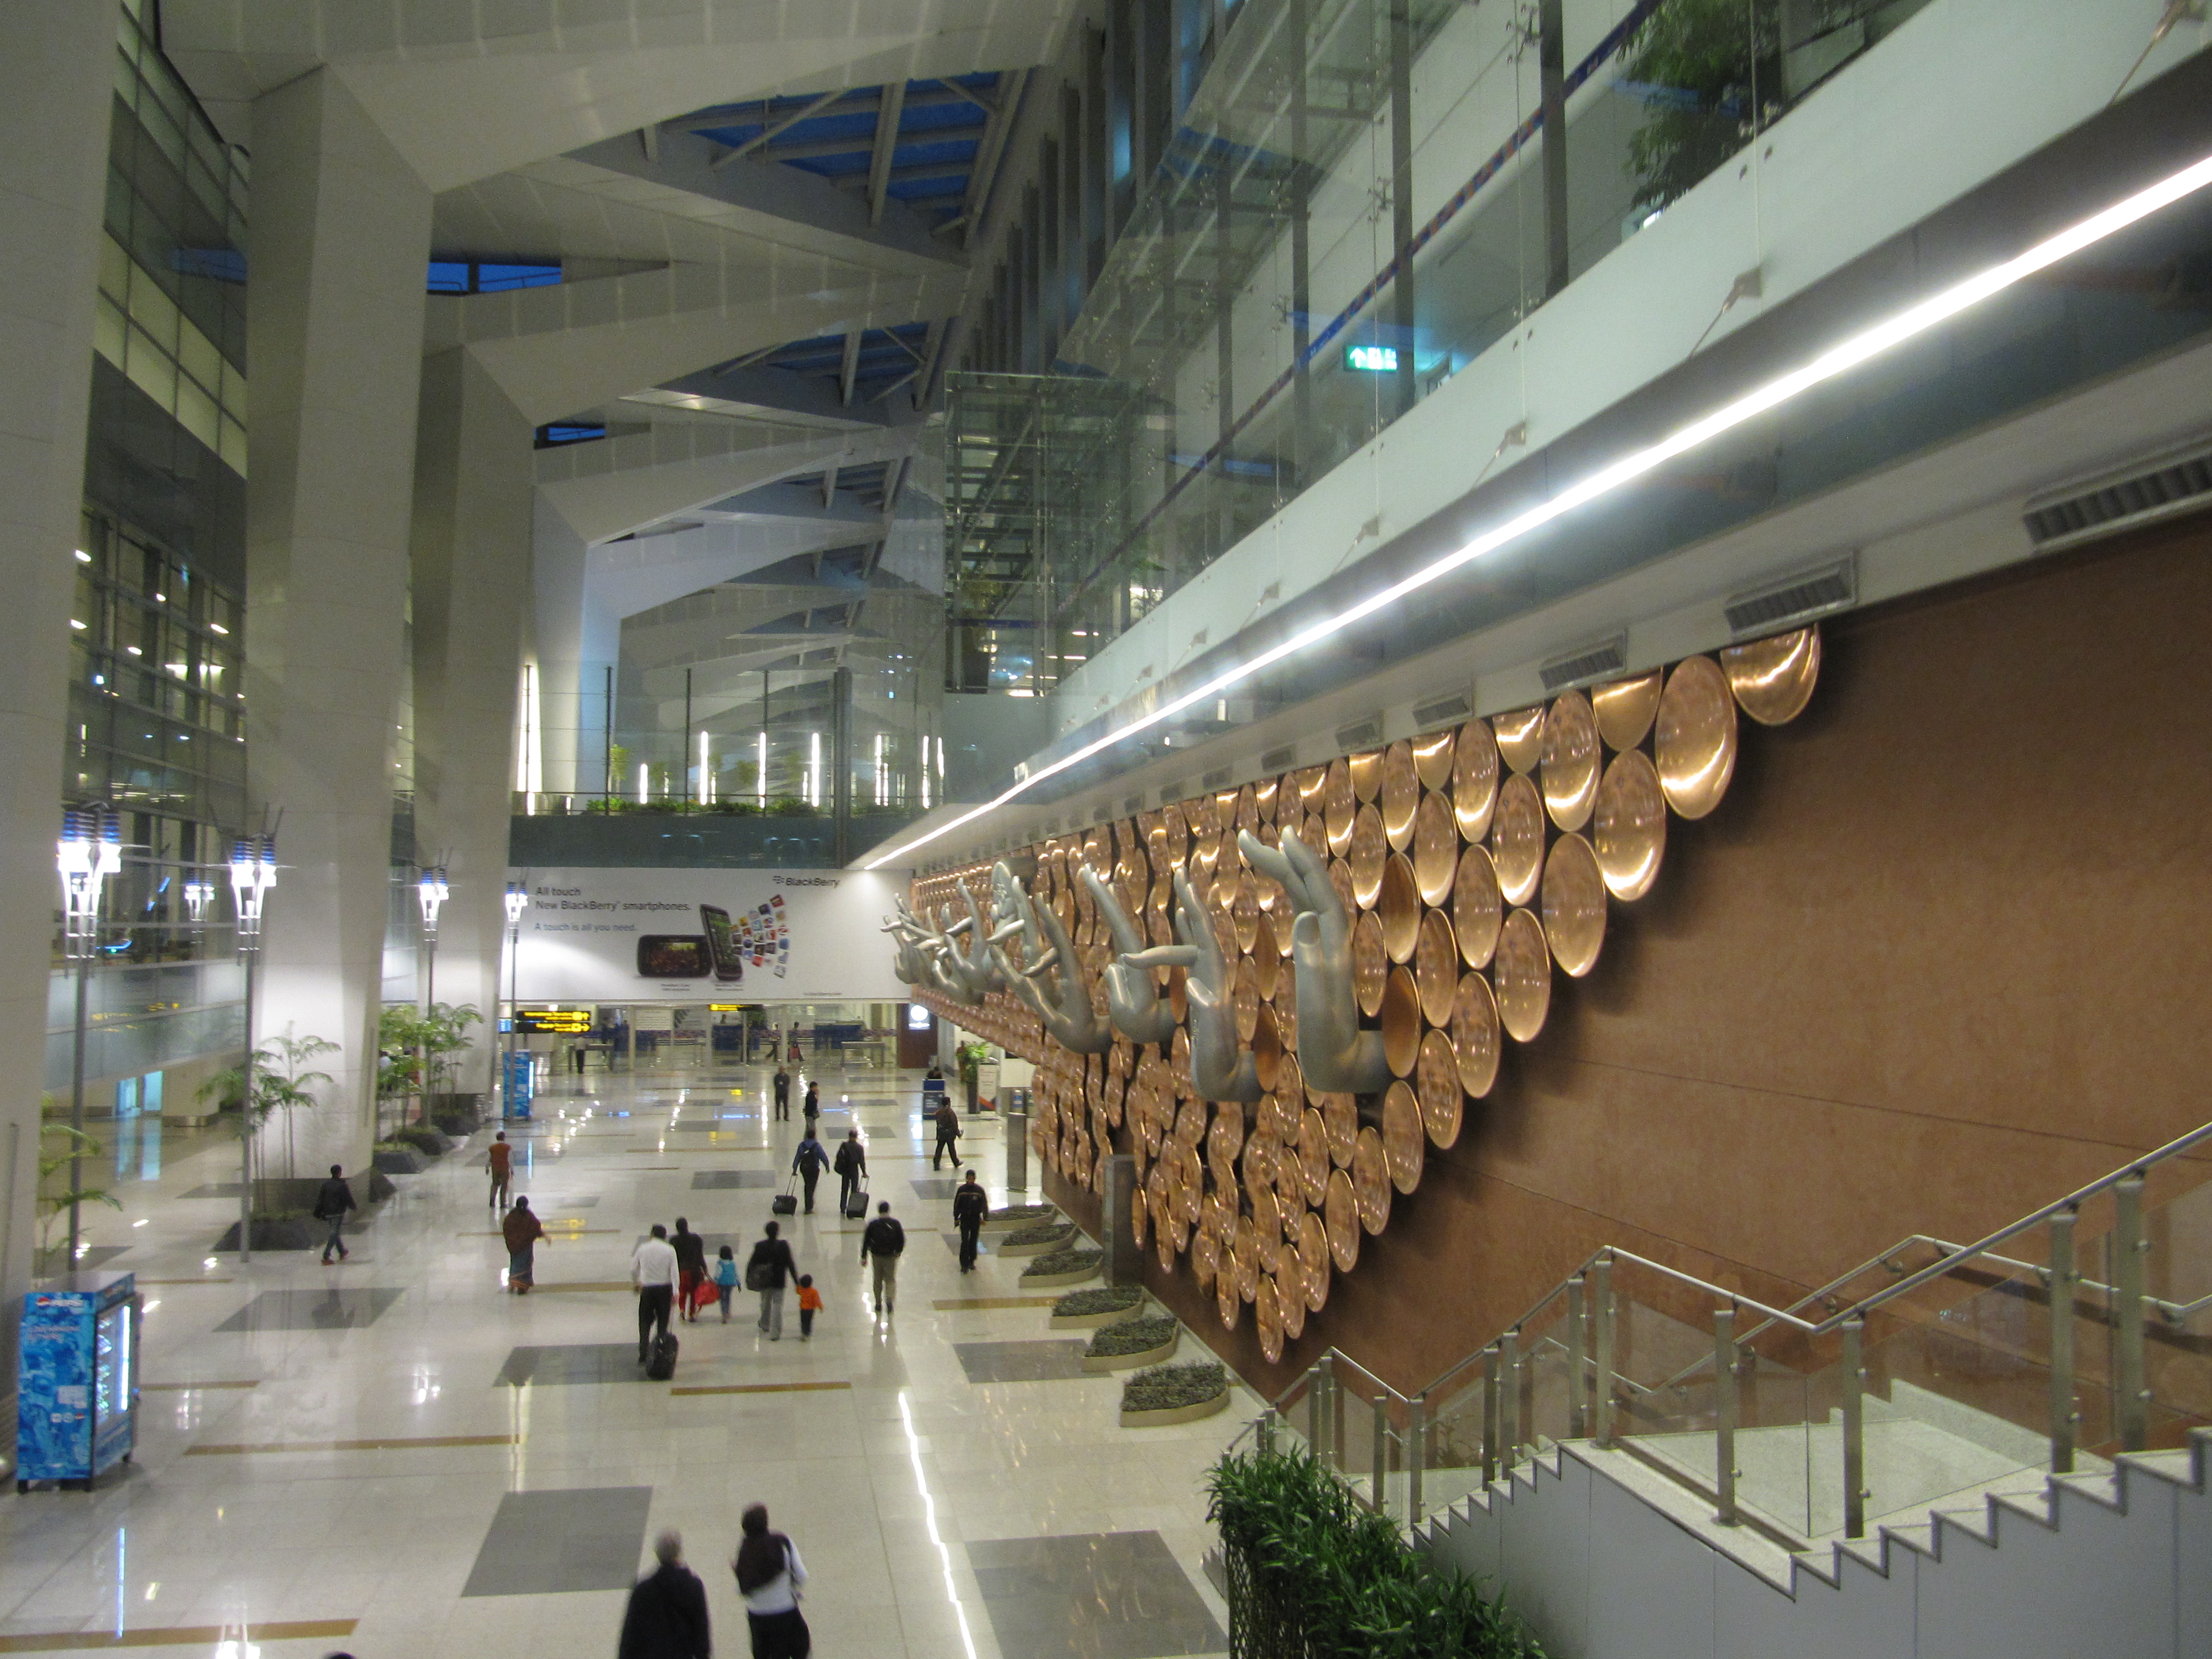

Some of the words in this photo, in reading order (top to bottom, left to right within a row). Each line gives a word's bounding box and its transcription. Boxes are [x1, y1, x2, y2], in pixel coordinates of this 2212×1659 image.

[786, 877, 839, 888] BlackBerry
[536, 886, 550, 896] All
[552, 886, 581, 896] touch
[536, 900, 557, 910] New
[623, 901, 691, 912] smartphones.
